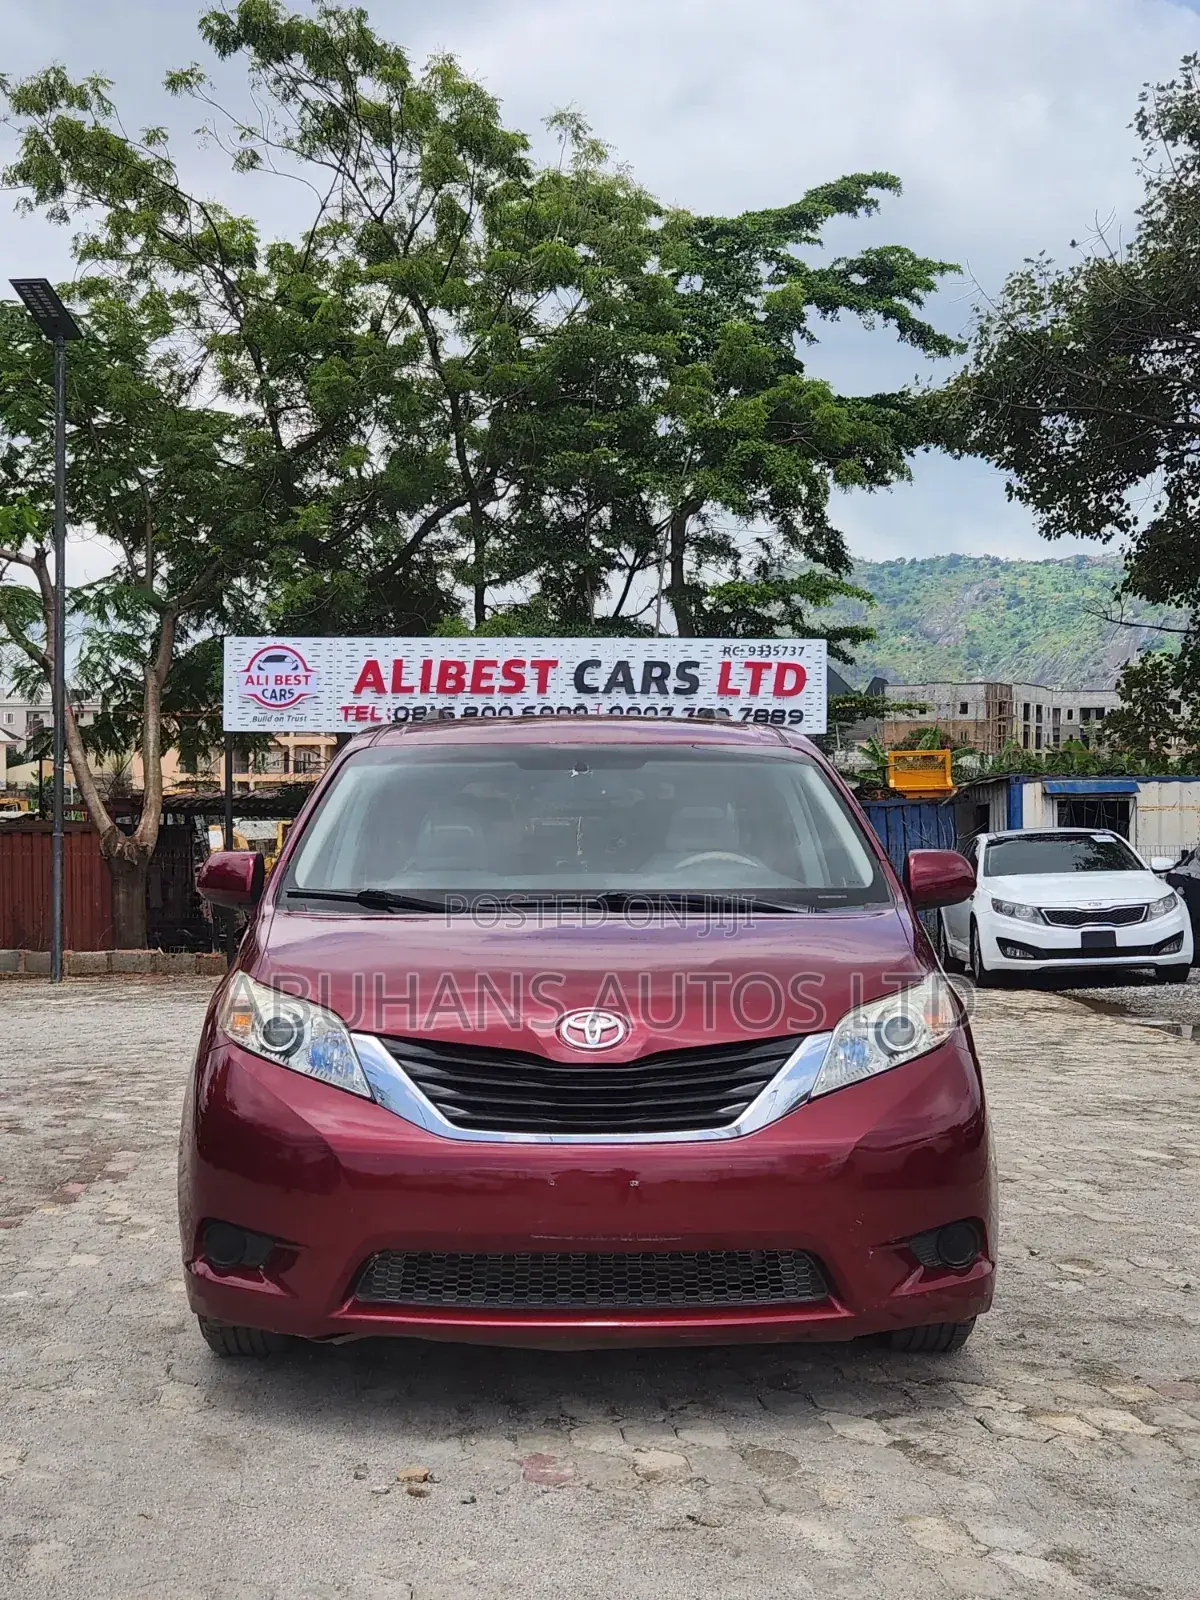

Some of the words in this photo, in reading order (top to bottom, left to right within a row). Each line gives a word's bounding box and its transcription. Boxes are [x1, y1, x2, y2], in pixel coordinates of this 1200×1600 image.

[245, 674, 269, 686] ALI
[274, 674, 312, 686] BEST
[353, 659, 559, 695] ALIBEST
[573, 660, 700, 696] CARS
[717, 661, 807, 697] LTD
[261, 688, 295, 701] CARS
[252, 714, 273, 723] Build
[287, 714, 308, 723] Trust
[738, 707, 804, 725] 7889
